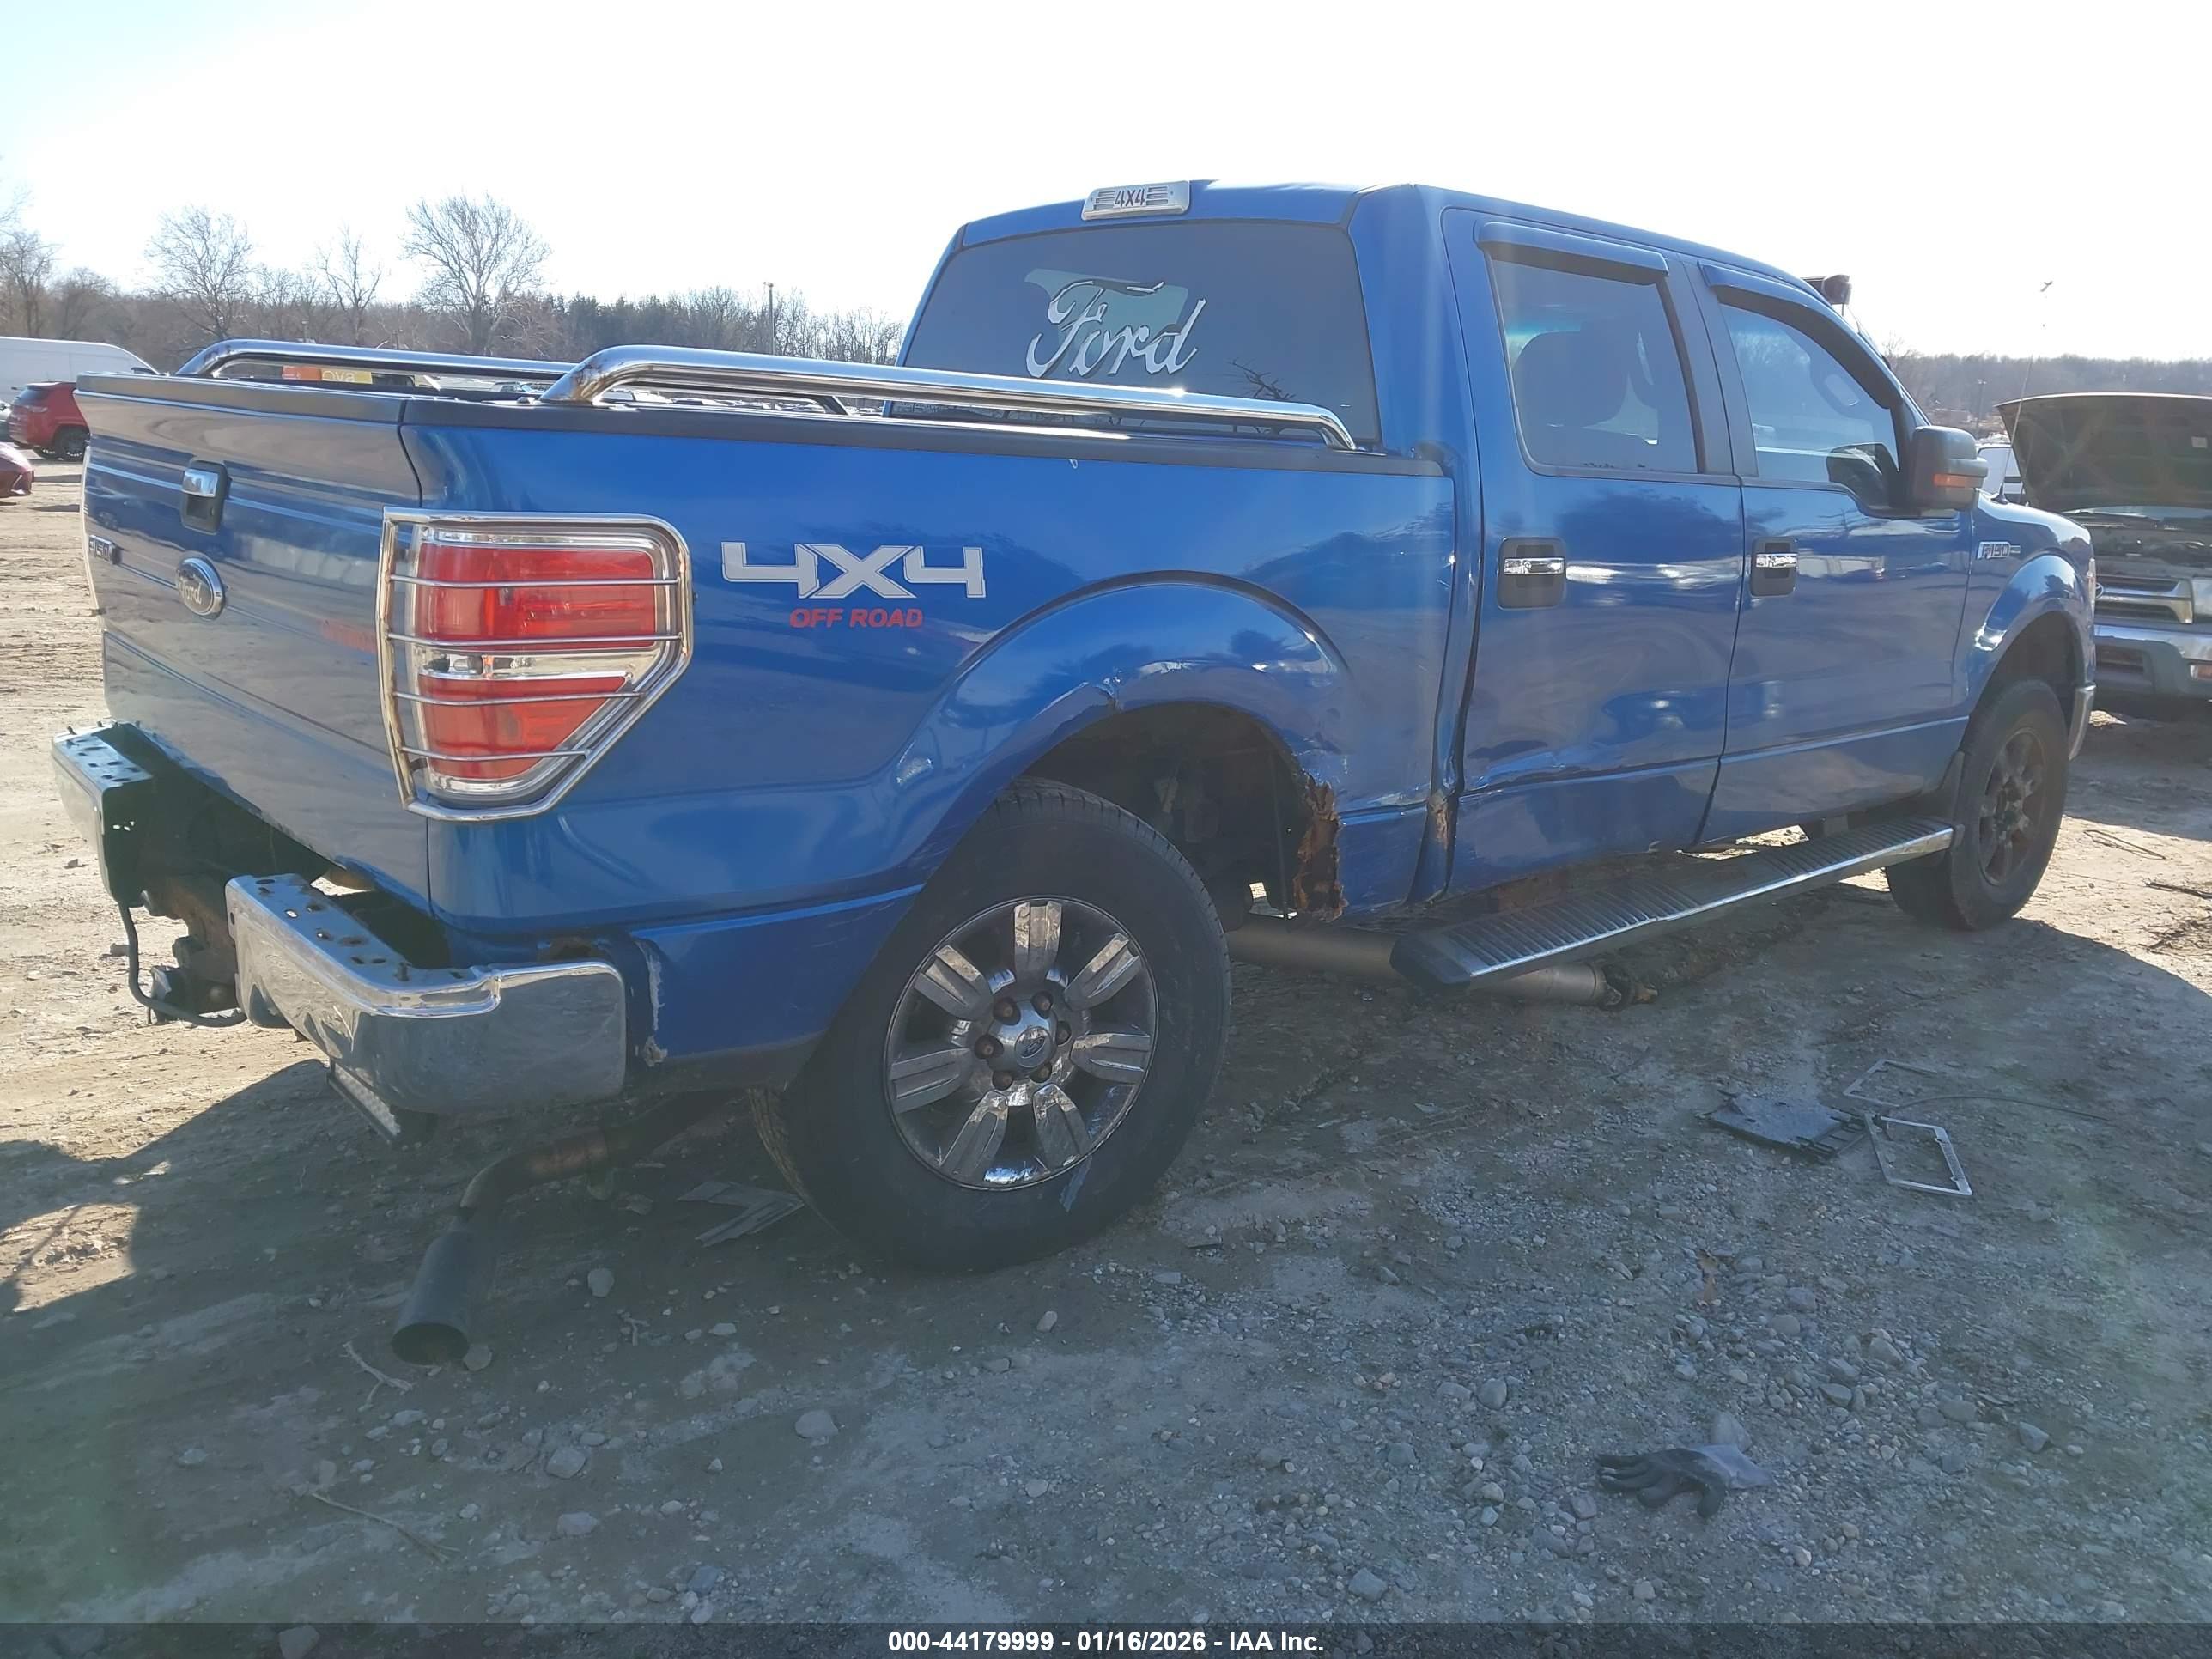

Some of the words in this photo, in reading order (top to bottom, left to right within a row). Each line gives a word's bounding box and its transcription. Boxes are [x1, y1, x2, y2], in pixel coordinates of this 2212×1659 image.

[1115, 188, 1146, 207] 4X4
[1026, 281, 1206, 378] Ford
[721, 541, 987, 599] 4X4
[789, 609, 843, 629] OFF
[848, 609, 925, 629] ROAD
